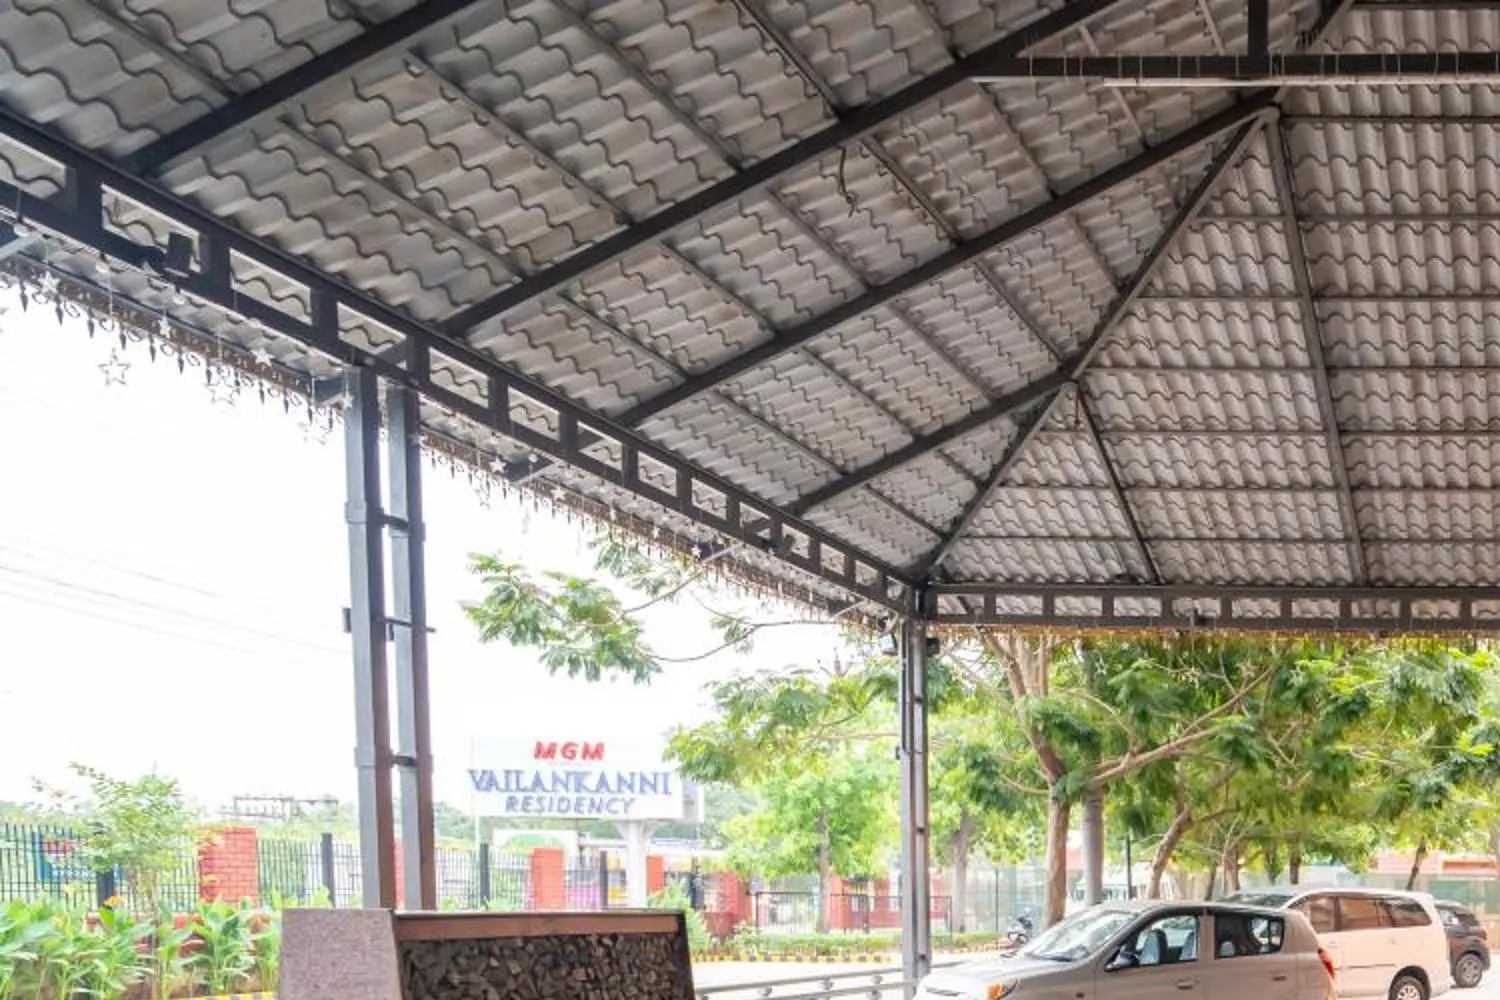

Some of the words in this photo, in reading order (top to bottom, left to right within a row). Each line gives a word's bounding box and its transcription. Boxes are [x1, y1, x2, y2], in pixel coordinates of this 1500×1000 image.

[534, 741, 605, 761] MGM
[466, 768, 672, 796] VAILANKANNI
[505, 795, 636, 815] RESIDENCY
